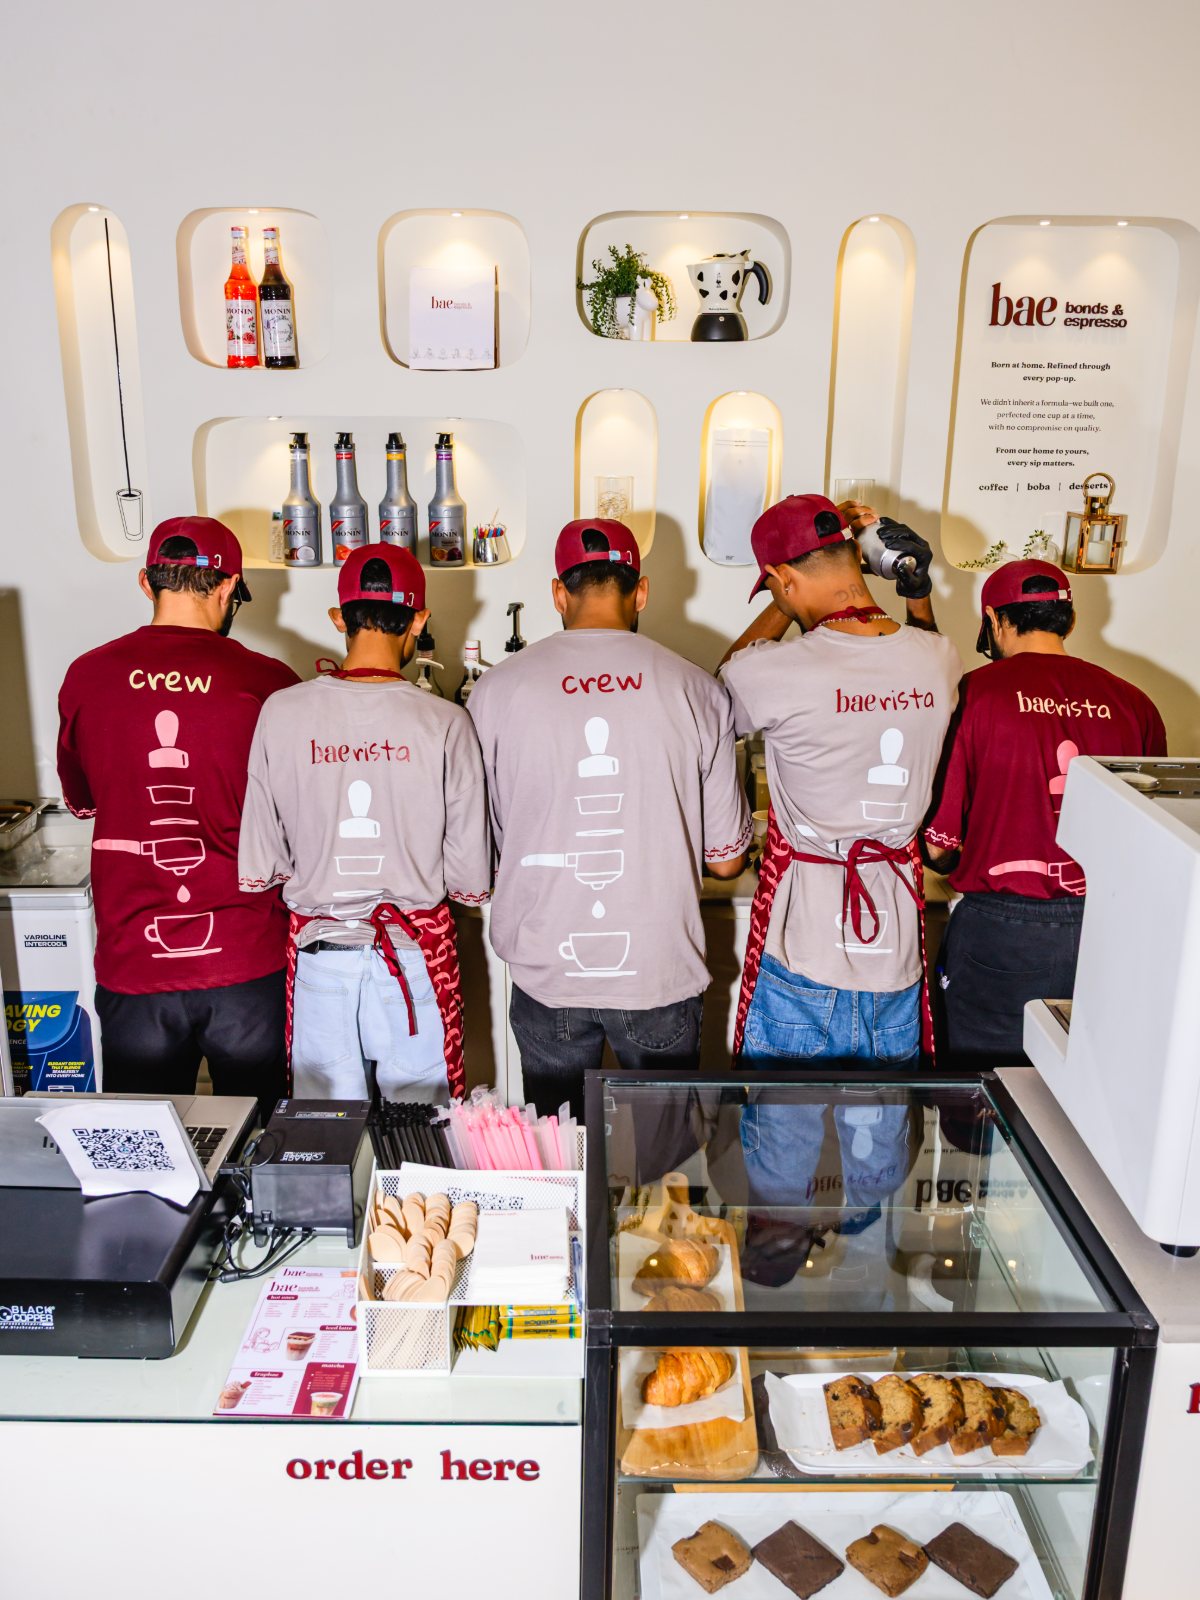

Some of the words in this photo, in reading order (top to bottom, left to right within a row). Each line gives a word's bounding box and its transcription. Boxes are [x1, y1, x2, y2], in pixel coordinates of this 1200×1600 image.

[431, 296, 453, 309] bae
[988, 281, 1058, 327] bae
[1065, 301, 1109, 315] bonds
[1112, 304, 1124, 316] &
[1063, 317, 1127, 330] espresso
[991, 361, 1010, 369] Born
[1047, 362, 1078, 370] Refined
[1079, 362, 1111, 372] through
[1022, 375, 1044, 383] every
[1045, 375, 1076, 383] pop-up.
[980, 398, 991, 406] We
[992, 398, 1011, 406] didn't
[1012, 399, 1035, 407] inherit
[1083, 400, 1099, 408] built
[996, 411, 1031, 420] perfected
[1047, 413, 1061, 421] cup
[1076, 412, 1095, 420] time,
[1016, 425, 1062, 433] compromise
[1074, 425, 1101, 433] quality.
[1032, 447, 1054, 455] home
[1064, 448, 1089, 456] yours,
[1029, 459, 1042, 467] sip
[978, 483, 1009, 491] coffee
[1027, 482, 1051, 491] boba
[129, 669, 212, 694] crew
[561, 672, 643, 695] crew
[836, 687, 934, 713] baerista
[1016, 690, 1112, 720] baerista
[310, 739, 411, 764] baerista
[270, 1281, 298, 1292] bae
[12, 1313, 54, 1322] COPPER
[286, 1449, 413, 1480] order
[440, 1449, 540, 1482] here
